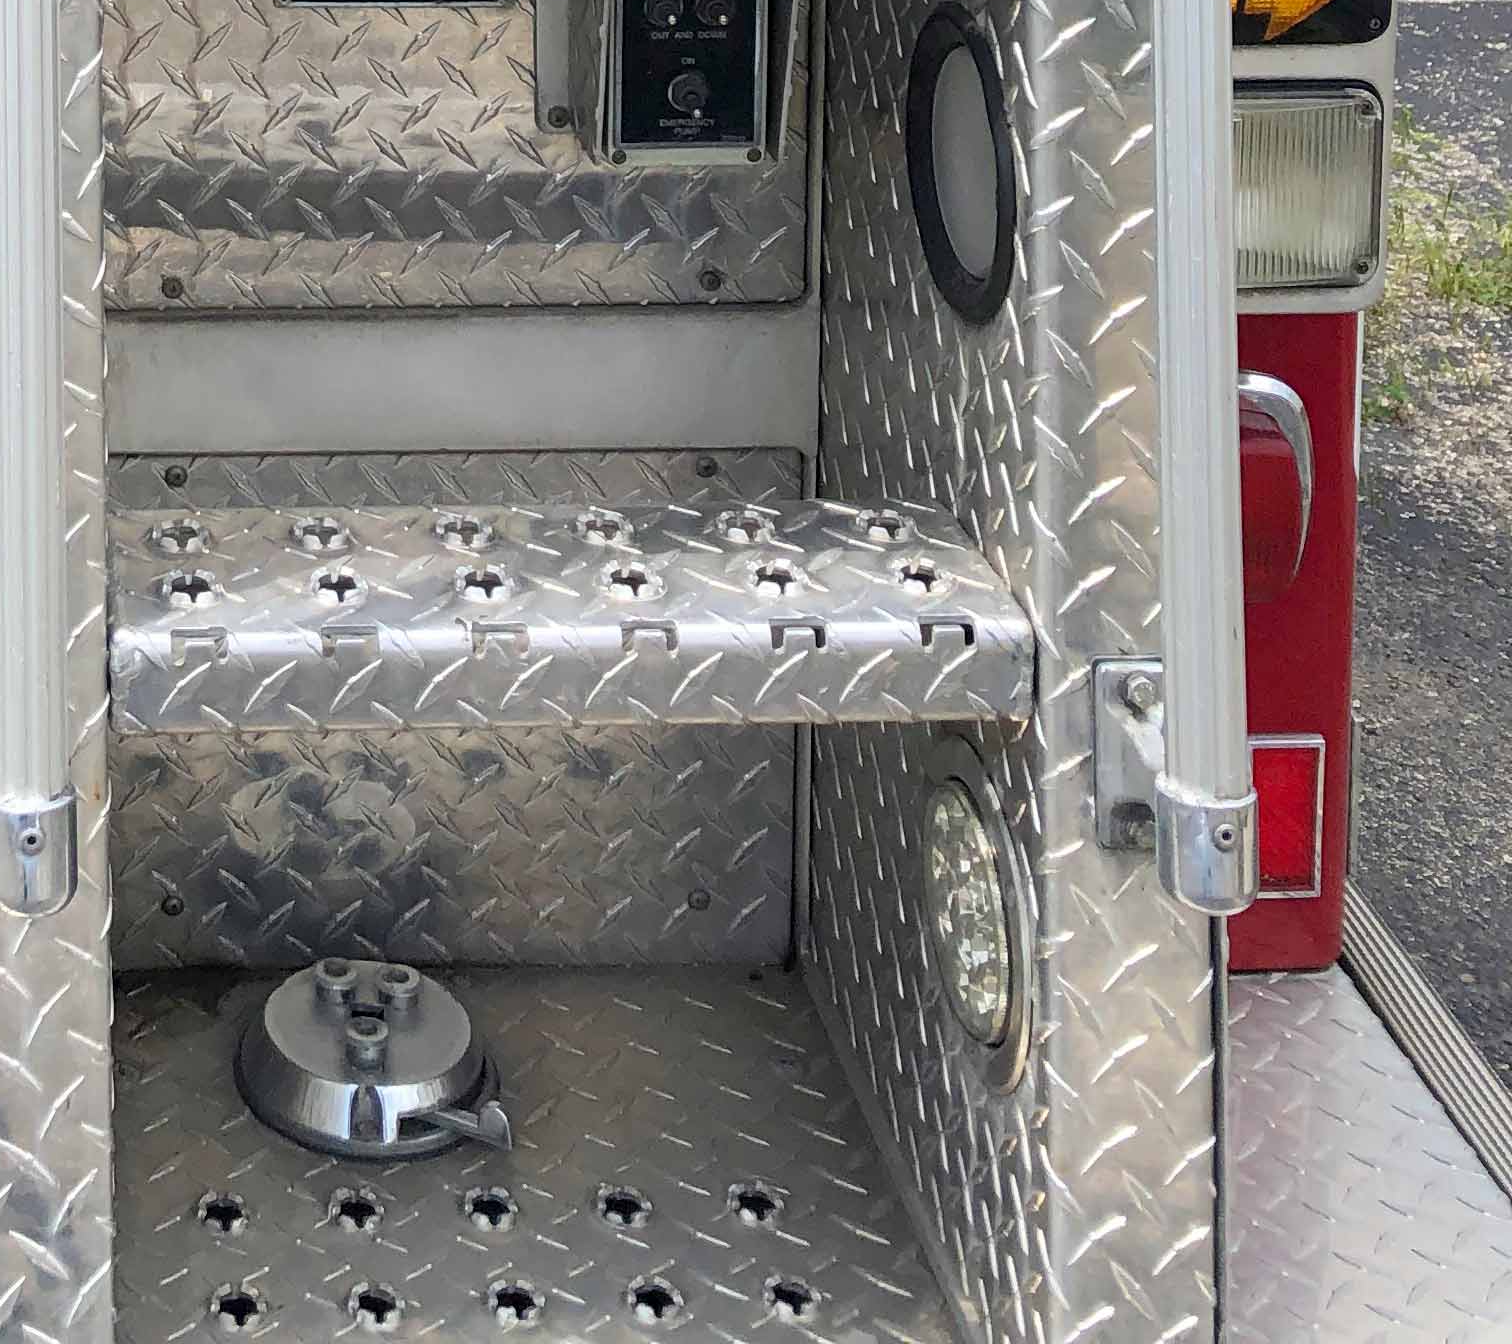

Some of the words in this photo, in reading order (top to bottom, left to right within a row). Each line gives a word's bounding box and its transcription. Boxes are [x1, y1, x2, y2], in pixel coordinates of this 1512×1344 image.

[651, 31, 669, 40] OUT
[674, 31, 694, 40] AND
[698, 31, 728, 40] DOWN
[681, 57, 695, 65] ON
[659, 118, 715, 127] EMERGENCY
